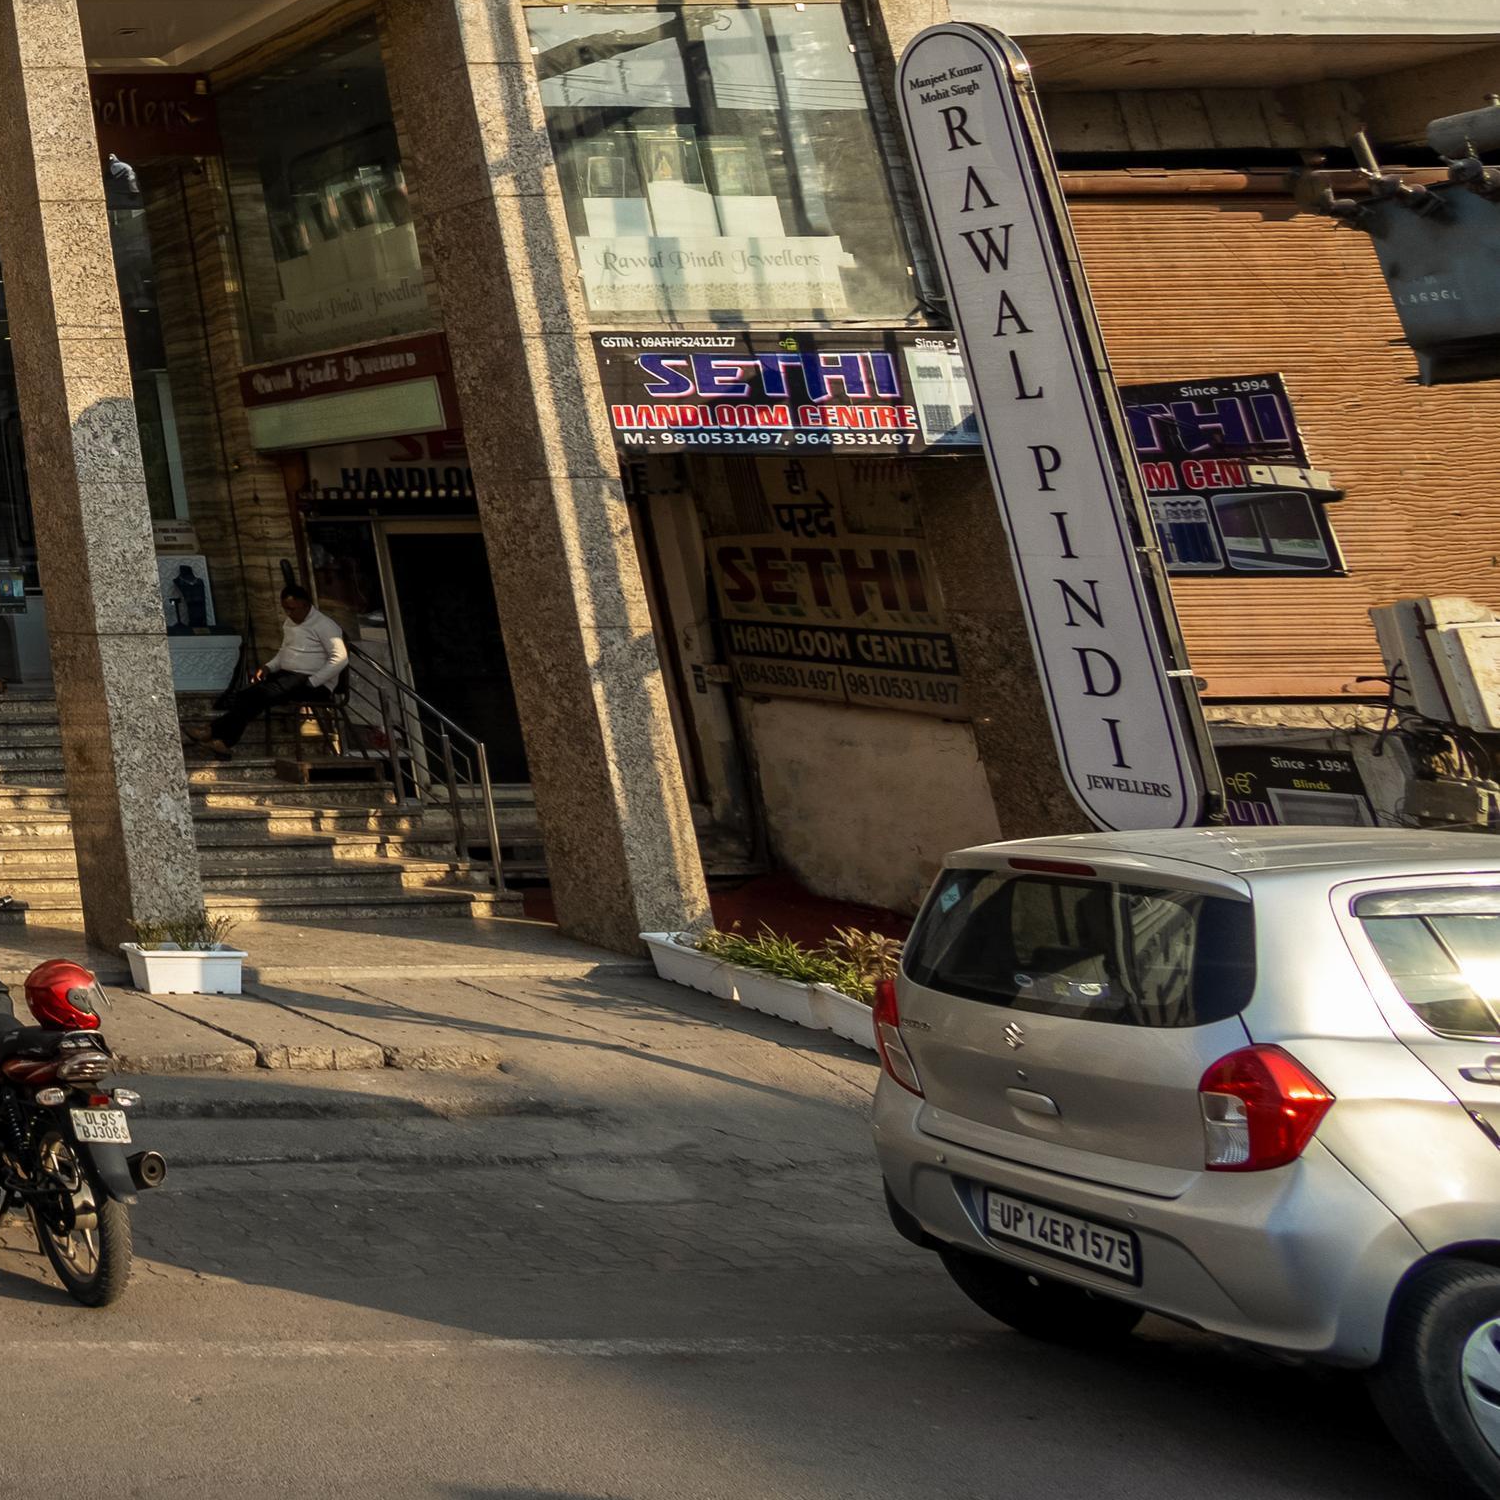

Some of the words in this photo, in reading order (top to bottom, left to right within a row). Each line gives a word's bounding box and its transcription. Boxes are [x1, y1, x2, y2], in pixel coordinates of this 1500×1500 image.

[909, 72, 948, 91] Manjeet
[948, 63, 984, 79] Kumar
[920, 89, 950, 105] Mohit
[950, 79, 980, 96] Singh
[601, 251, 664, 276] Rawal
[669, 249, 724, 273] Pindi
[731, 250, 821, 274] Jewellers
[601, 338, 634, 348] GSTIN
[915, 338, 944, 349] Since
[638, 352, 901, 402] SETHI
[1180, 385, 1219, 398] Since
[1232, 379, 1271, 393] 1994
[611, 404, 797, 430] HANDLOOM
[798, 404, 918, 429] CENTRE
[624, 433, 655, 444] M.:
[661, 432, 789, 445] 9810531497,
[795, 432, 915, 445] 9643531497
[716, 546, 930, 617] SETHI
[731, 623, 850, 660] HANDLOOM
[856, 634, 953, 669] CENTRE
[1270, 756, 1306, 770] Since
[1086, 772, 1173, 800] JEWELLERS
[1292, 778, 1331, 791] Blinds
